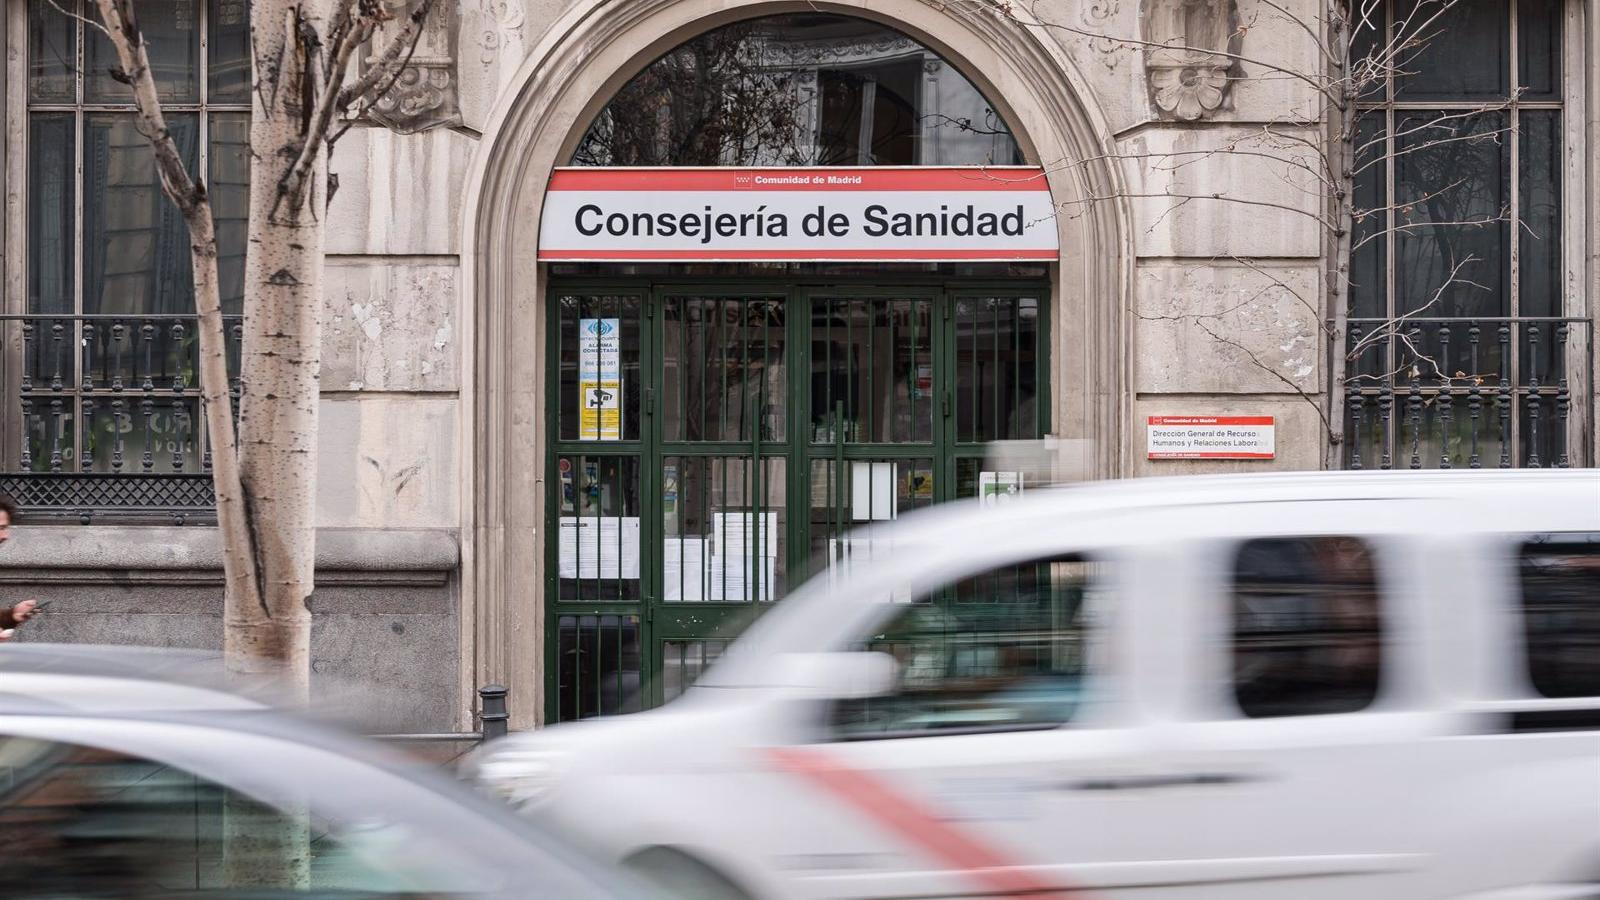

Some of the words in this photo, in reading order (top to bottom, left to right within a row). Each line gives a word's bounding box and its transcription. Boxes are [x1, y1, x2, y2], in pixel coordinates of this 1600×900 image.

[754, 175, 810, 185] Comunidad
[812, 175, 825, 185] de
[827, 175, 862, 185] Madrid
[574, 204, 788, 244] Consejería
[801, 204, 850, 237] de
[863, 204, 1025, 237] Sanidad
